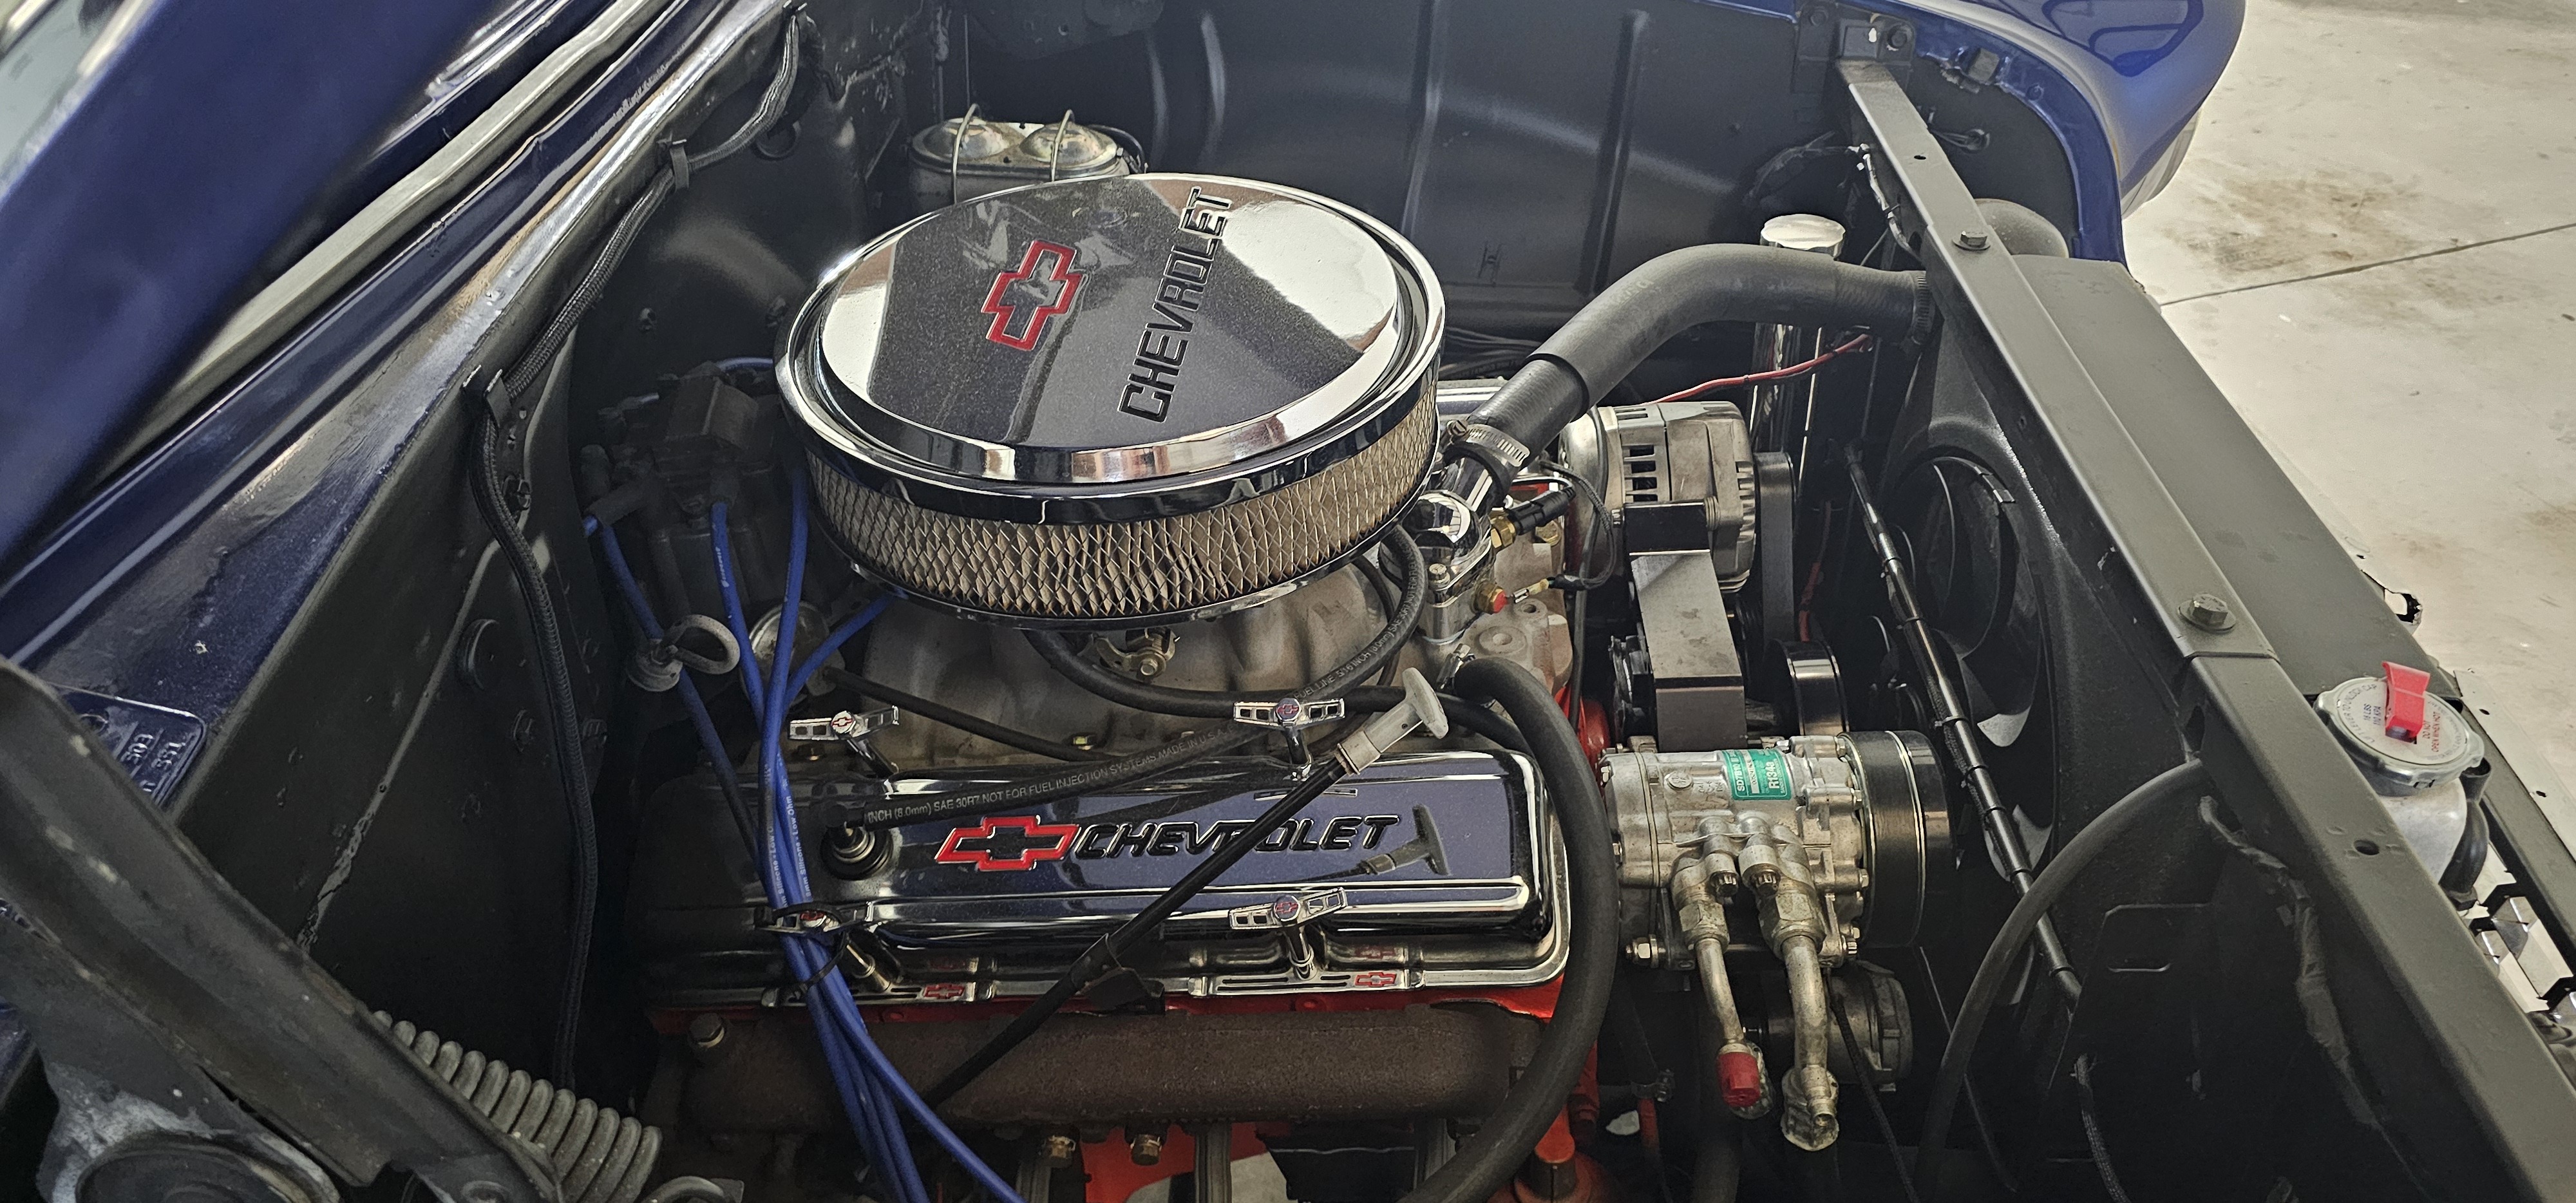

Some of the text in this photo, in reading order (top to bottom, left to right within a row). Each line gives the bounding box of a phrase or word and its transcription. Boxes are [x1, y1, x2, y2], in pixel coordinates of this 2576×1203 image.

[1117, 186, 1233, 422] CHEVROLET
[1408, 574, 1417, 589] FOR
[1404, 589, 1415, 604] NOT
[1388, 619, 1403, 632] SAE
[1352, 652, 1371, 667] INCH
[1315, 674, 1336, 689] LINE
[1293, 687, 1314, 699] FUEL
[2422, 731, 2430, 739] DO
[2431, 739, 2439, 752] OPEN
[934, 799, 953, 811] SAE
[956, 795, 980, 810] 30R7
[981, 791, 1003, 804] NOT
[1006, 786, 1027, 800] FOR
[1029, 782, 1055, 795] FUEL
[1056, 767, 1109, 790] INJECTION
[1110, 755, 1157, 775] SYSTEMS
[1159, 742, 1184, 758] MADE
[1186, 735, 1200, 748] IN
[1765, 761, 1780, 789] R134a
[786, 795, 795, 816] Ohm
[795, 842, 806, 875] Silicone
[773, 860, 784, 895] Silicone
[802, 876, 812, 897] 8mm
